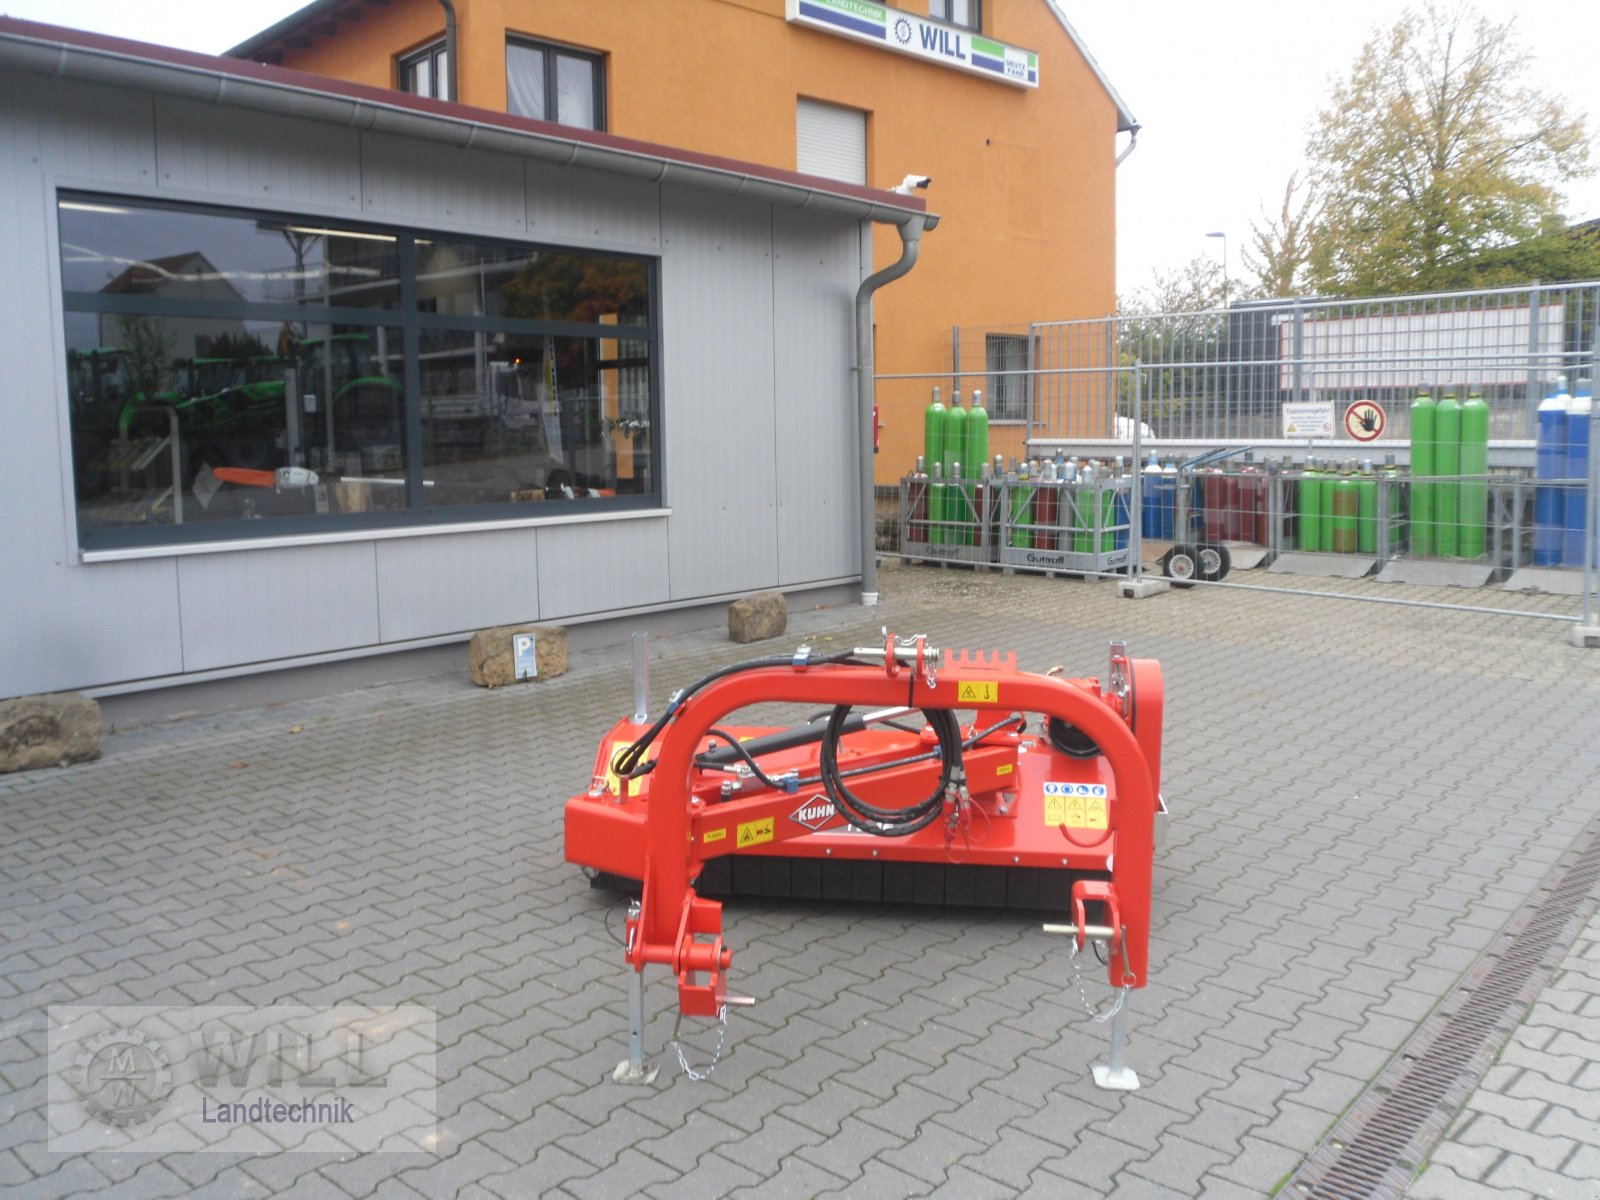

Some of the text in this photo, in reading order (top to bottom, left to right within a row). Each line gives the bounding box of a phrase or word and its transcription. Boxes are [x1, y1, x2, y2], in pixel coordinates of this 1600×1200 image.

[919, 23, 966, 60] WILL
[517, 637, 531, 657] P
[798, 804, 835, 822] KUHN
